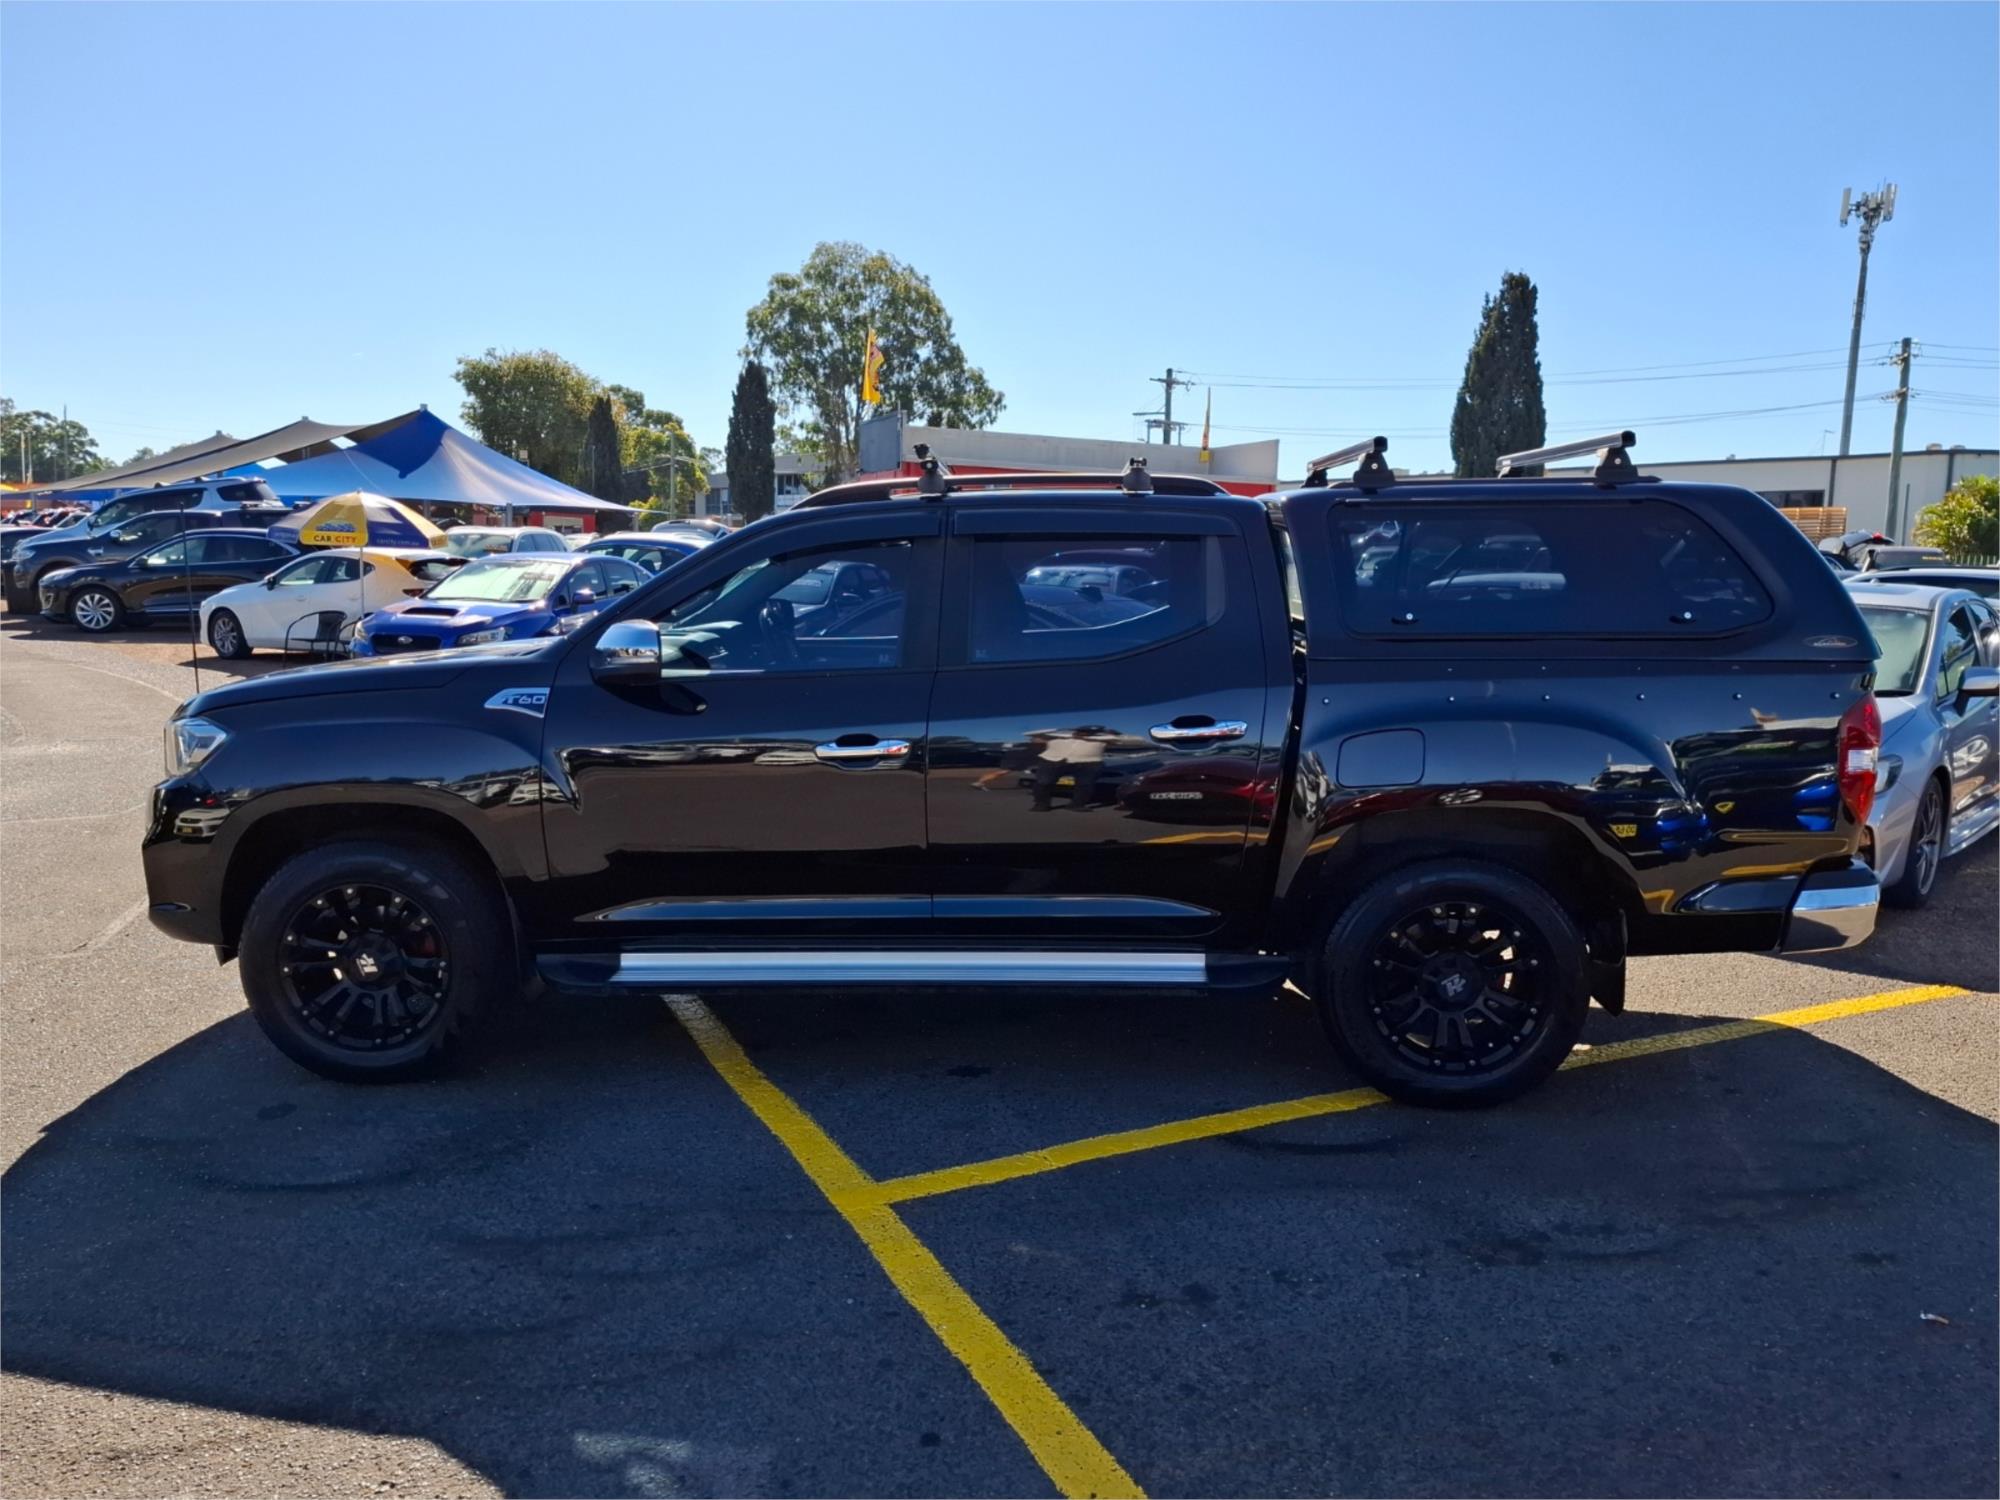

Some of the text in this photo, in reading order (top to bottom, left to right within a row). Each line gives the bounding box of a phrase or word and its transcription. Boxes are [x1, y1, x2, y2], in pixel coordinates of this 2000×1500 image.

[313, 534, 358, 544] CAR CITY
[506, 695, 546, 704] T60
